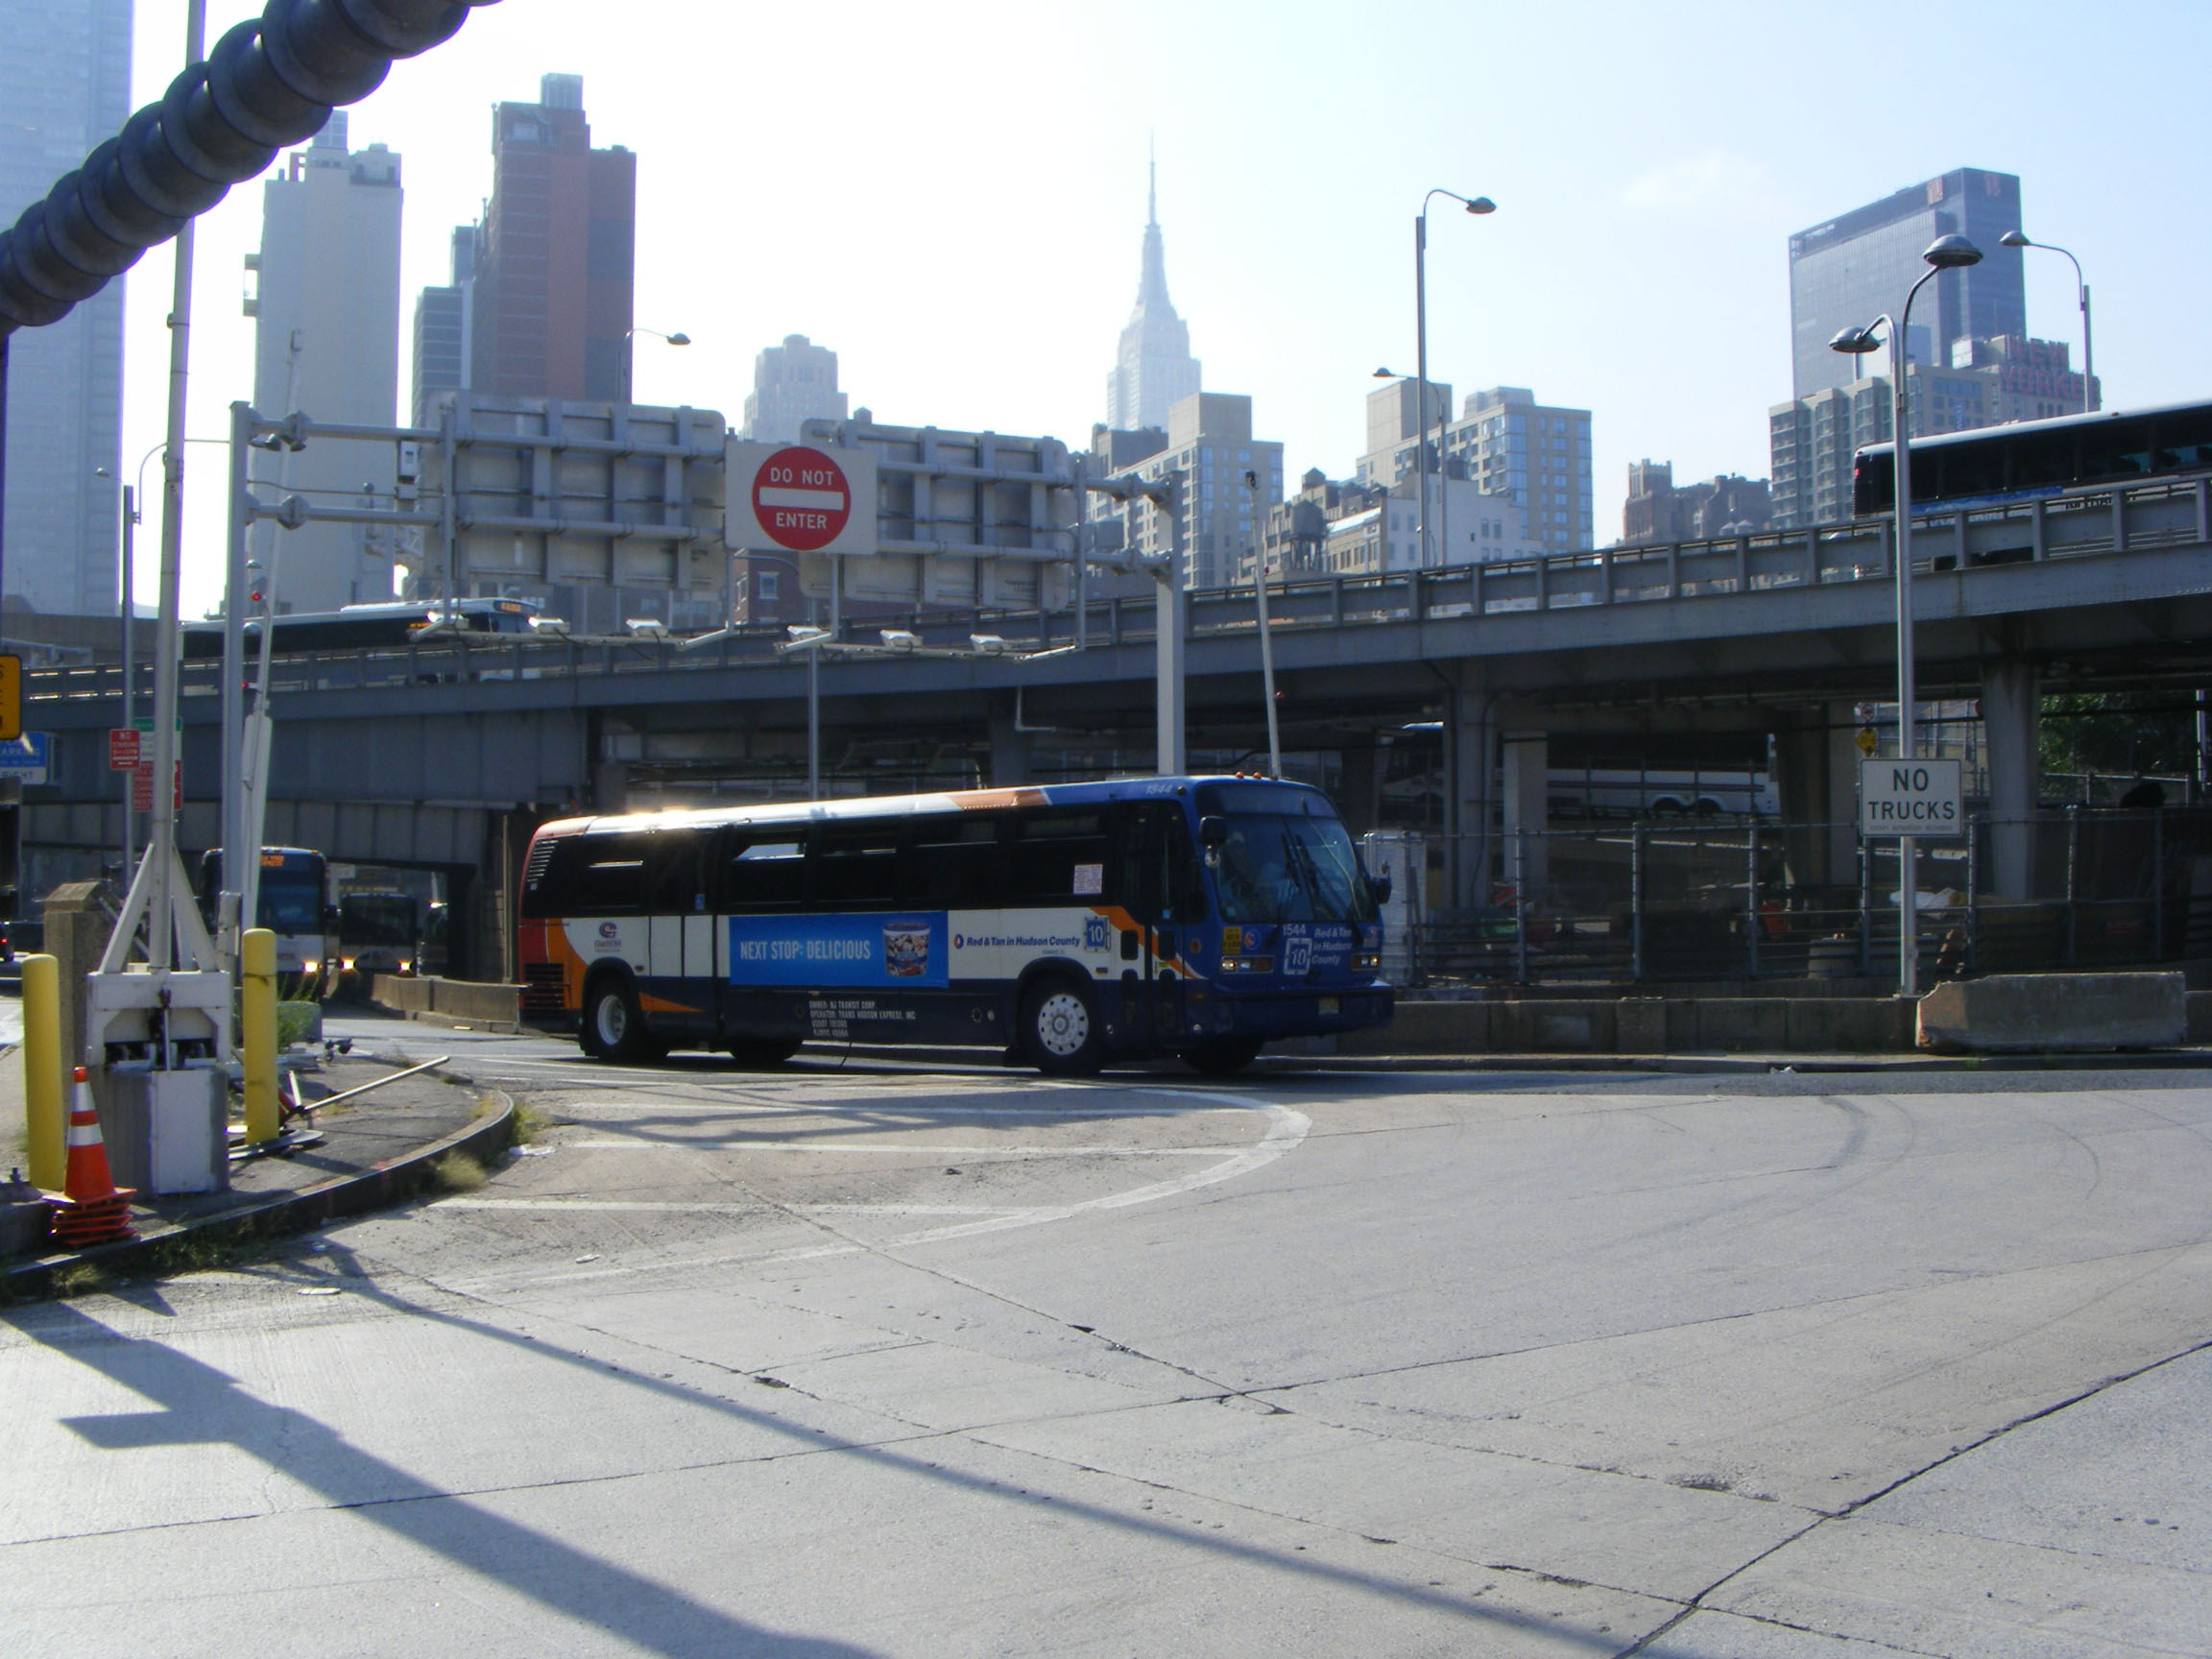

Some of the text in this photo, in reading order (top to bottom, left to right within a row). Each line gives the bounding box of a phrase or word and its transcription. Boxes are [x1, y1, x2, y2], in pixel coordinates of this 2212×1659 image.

[770, 467, 834, 486] DO NOT
[775, 512, 828, 530] ENTER
[1892, 768, 1929, 792] NO
[1867, 801, 1955, 820] TRUCKS
[1088, 925, 1104, 943] 10
[1283, 924, 1307, 937] 1544
[1314, 927, 1332, 938] Red
[740, 939, 871, 960] NEXT STOP: DELICIOUS
[967, 936, 1081, 949] Red & Tan in Hudson County
[1291, 949, 1308, 966] 10
[1311, 954, 1341, 966] County
